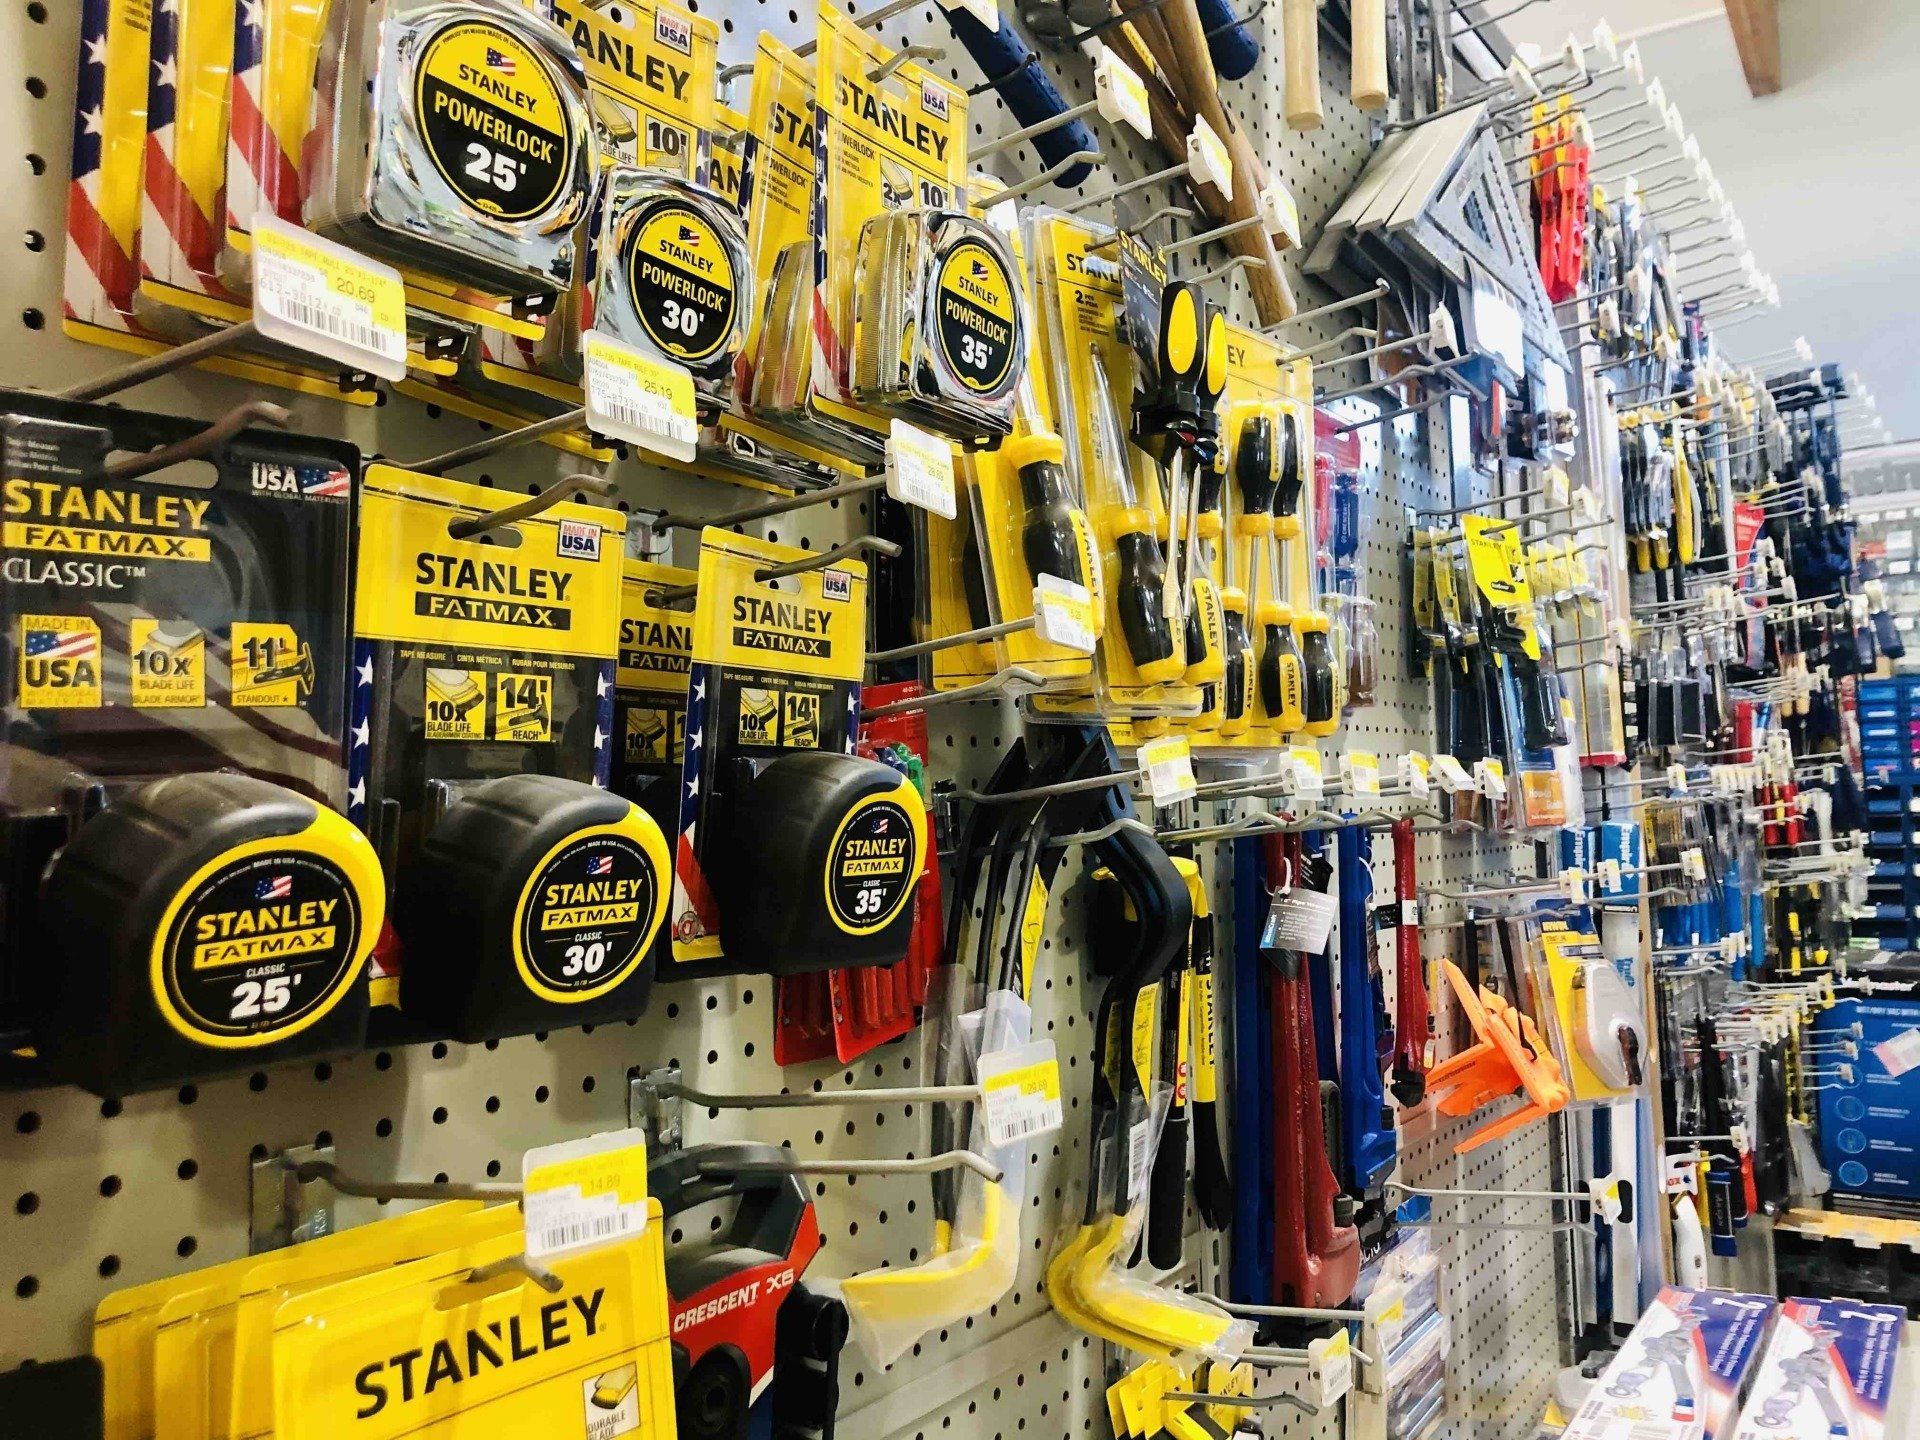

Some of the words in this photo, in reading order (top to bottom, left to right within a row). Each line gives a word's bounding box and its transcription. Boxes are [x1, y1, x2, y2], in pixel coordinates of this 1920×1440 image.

[659, 24, 688, 48] USA
[551, 8, 691, 101] TANLEY
[459, 64, 538, 114] STANLEY
[923, 92, 946, 114] USA
[434, 90, 553, 164] POWERLOCK
[834, 73, 949, 162] STANLEY
[465, 142, 527, 193] 25'
[659, 239, 715, 274] STANLEY
[336, 277, 376, 304] 20.69
[642, 262, 726, 313] POWERLOCK
[958, 275, 1000, 307] STANLEY
[662, 299, 705, 337] 30'
[945, 297, 1008, 346] POWERLOCK
[960, 334, 993, 370] 35'
[644, 379, 673, 401] 25.19
[251, 467, 299, 493] USA
[5, 478, 212, 531] STANLEY
[25, 526, 188, 558] FATMAX
[562, 536, 595, 552] USA
[563, 522, 586, 537] MADE
[587, 527, 597, 538] IN
[416, 552, 573, 602] STANLEY
[826, 580, 848, 594] USA
[26, 617, 68, 630] MADE
[430, 597, 554, 627] FATMAX
[733, 595, 833, 636] STANLEY
[1201, 585, 1219, 649] STANLEY
[242, 637, 286, 669] 11'
[400, 649, 415, 659] TAPE
[416, 650, 447, 661] MEASURE
[742, 630, 821, 655] FATMAX
[25, 659, 97, 688] USA
[134, 649, 192, 677] 10x
[456, 654, 476, 664] CINTA
[139, 679, 174, 690] BLADE
[175, 680, 195, 691] LIFE
[500, 677, 548, 711] 14'
[1246, 655, 1254, 710] STANLEY
[1286, 661, 1296, 708] STANLEY
[236, 694, 281, 705] STANDOUT
[428, 700, 467, 723] 10x
[787, 695, 817, 722] 14'
[427, 721, 454, 733] BLADE
[455, 722, 472, 733] LIFE
[512, 729, 539, 741] REACH
[739, 729, 757, 740] BLADE
[757, 731, 768, 741] LIFE
[845, 837, 907, 858] STANLEY
[846, 860, 900, 874] FATMAX
[545, 878, 643, 907] STANLEY
[862, 879, 881, 888] CLASSIC
[548, 905, 634, 926] FATMAX
[854, 888, 887, 915] 35'
[196, 898, 339, 942] STANLEY
[203, 930, 327, 964] FATMAX
[574, 931, 603, 943] CLASSIC
[246, 963, 286, 978] CLASSIC
[562, 941, 613, 977] 30'
[229, 973, 302, 1020] 25'
[673, 1281, 761, 1333] CRESCENT
[354, 1287, 606, 1420] STANLEY
[587, 1409, 627, 1434] DURABLE
